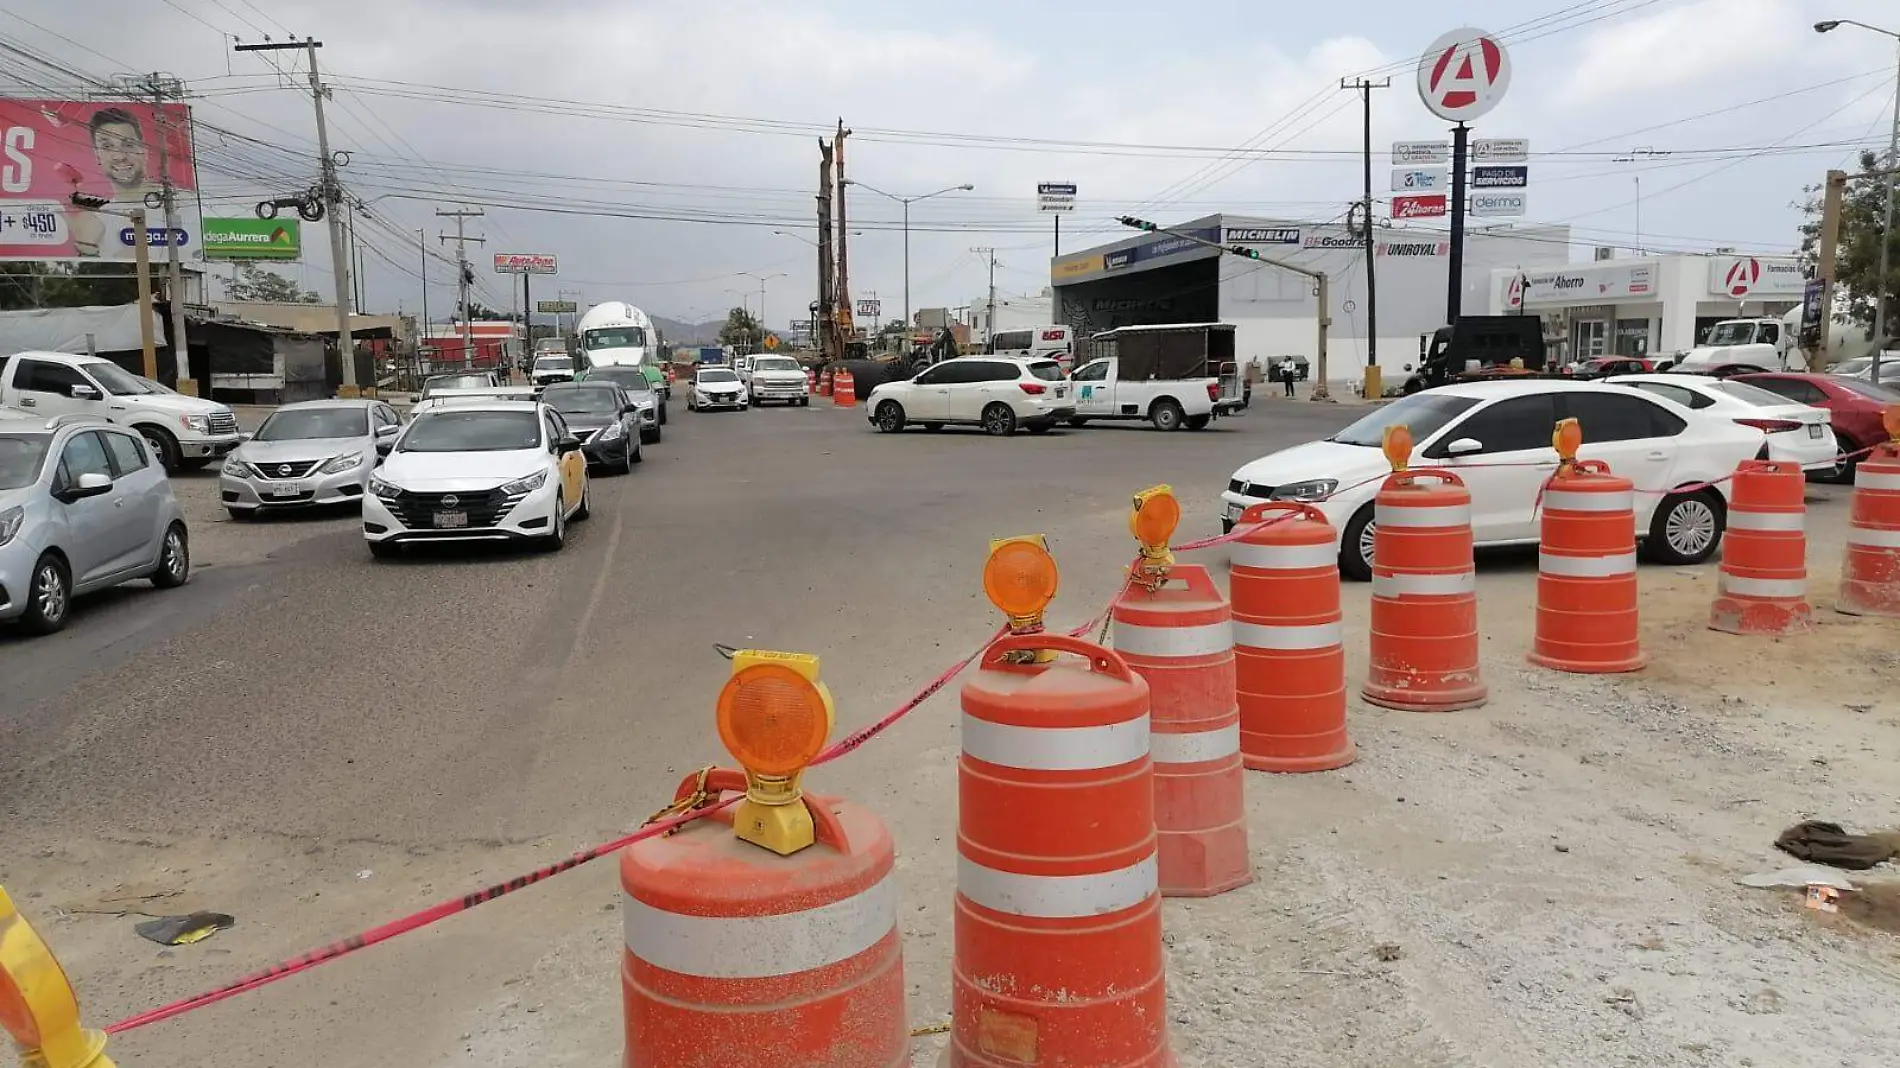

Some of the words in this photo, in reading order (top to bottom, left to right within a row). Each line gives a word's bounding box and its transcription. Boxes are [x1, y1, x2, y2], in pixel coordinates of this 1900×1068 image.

[0, 126, 35, 193] S
[1476, 196, 1521, 208] derma
[22, 212, 57, 232] $450
[125, 232, 184, 243] mga.x
[1228, 229, 1299, 240] MICHELIN
[1387, 243, 1437, 256] UNIROYAL
[1554, 275, 1585, 289] Ahorro
